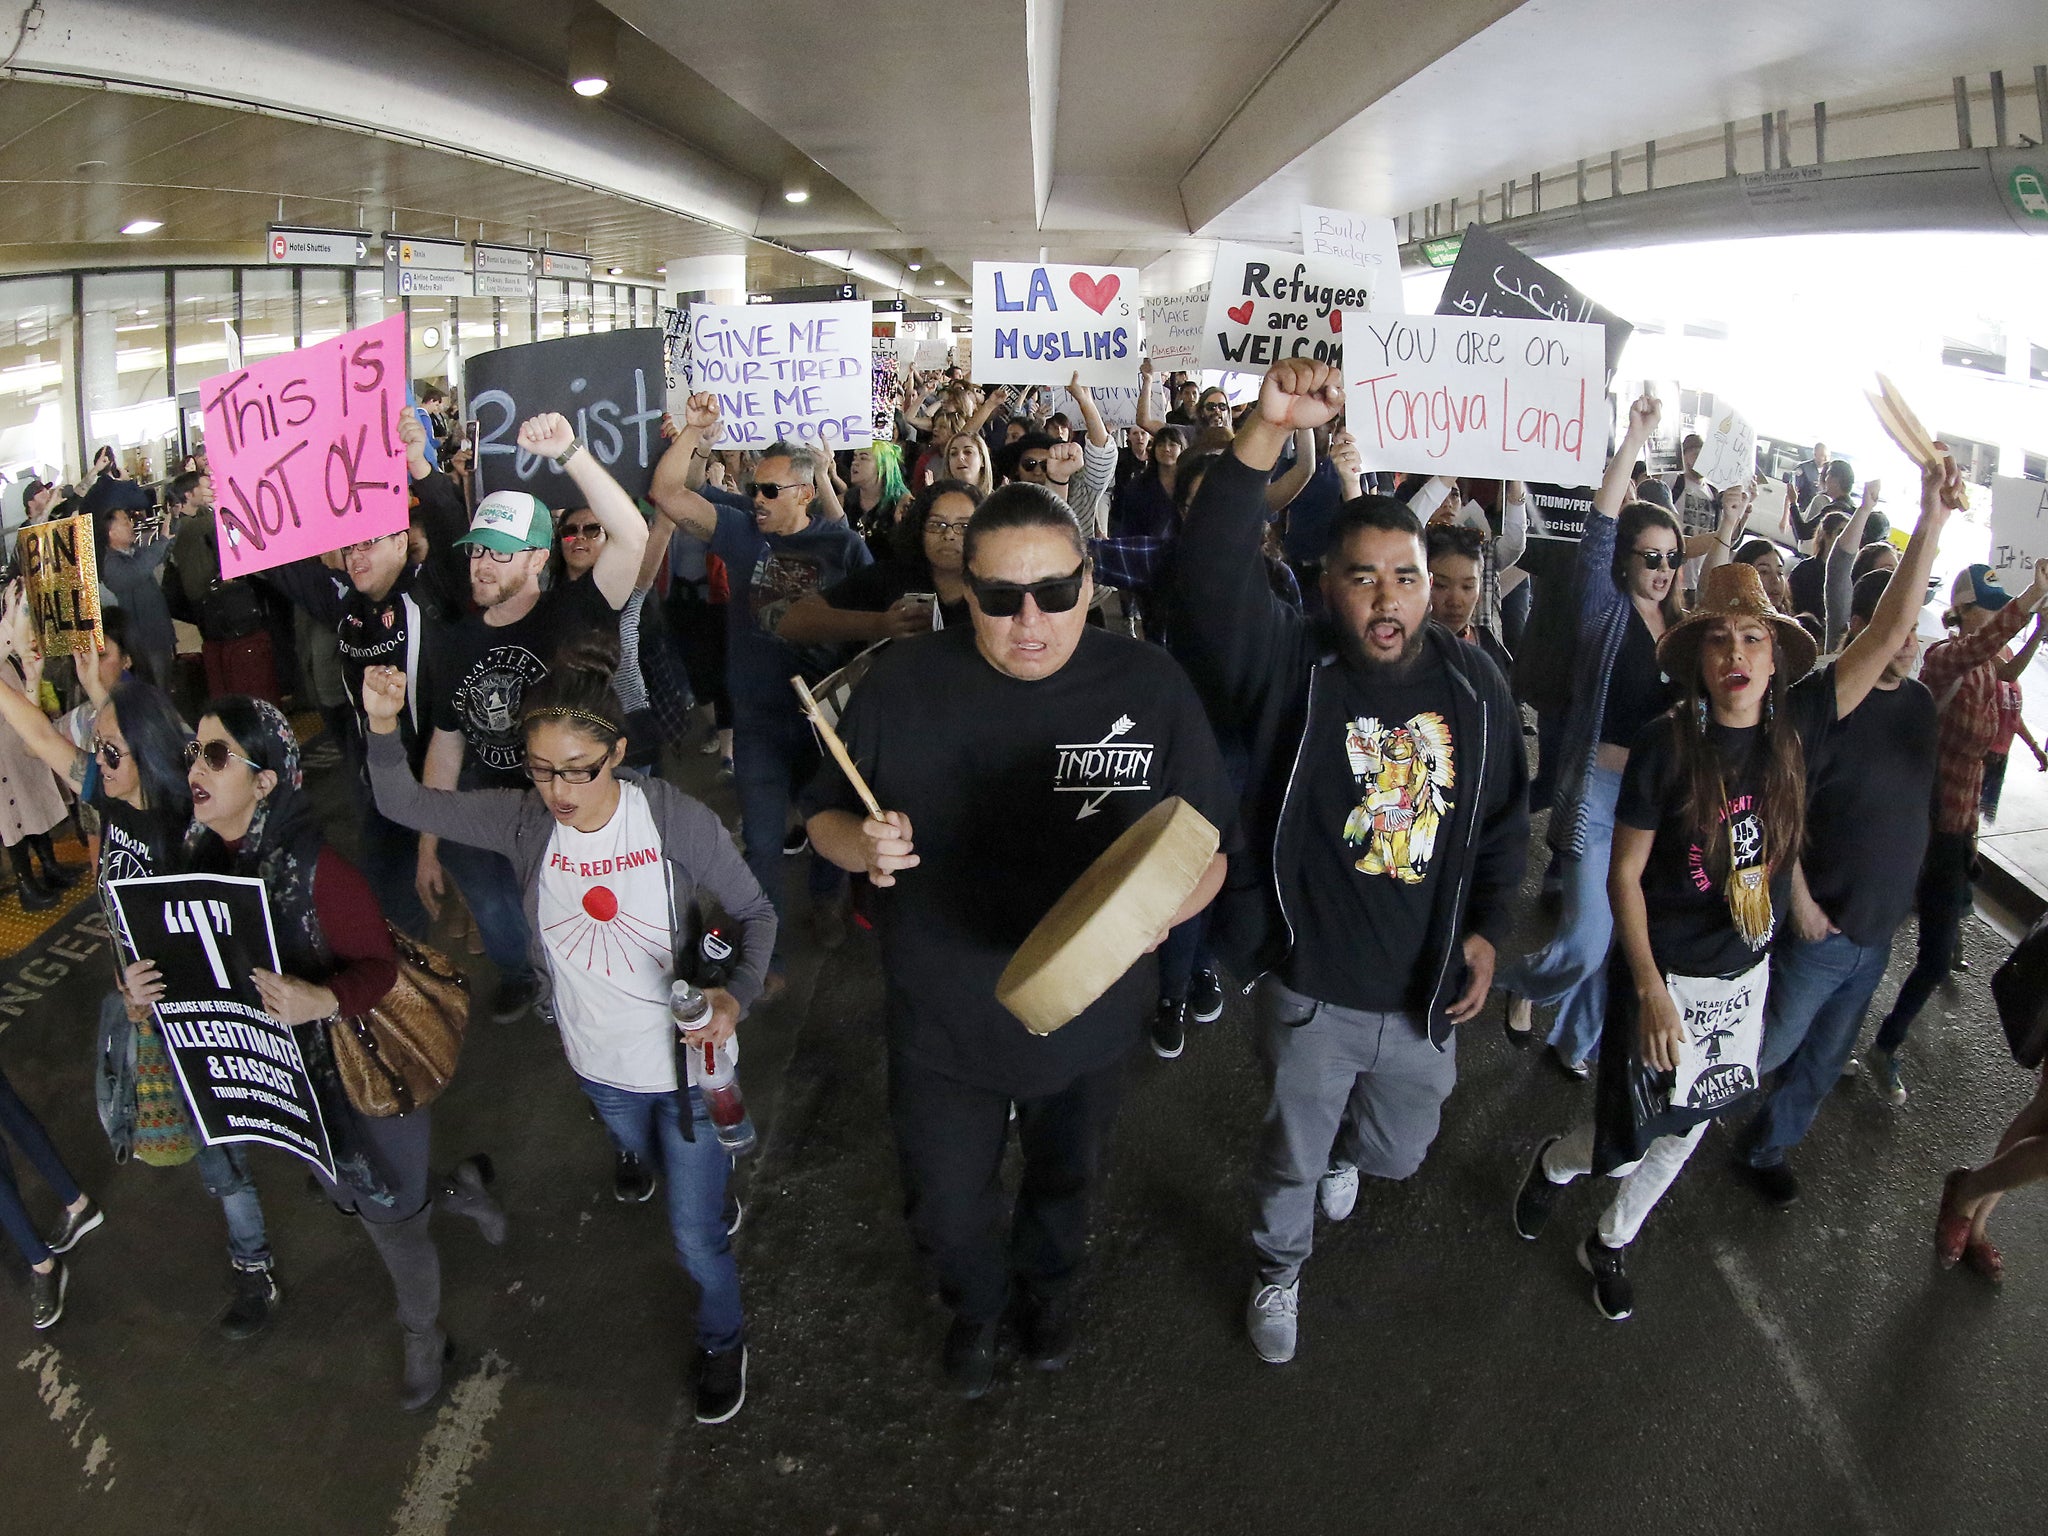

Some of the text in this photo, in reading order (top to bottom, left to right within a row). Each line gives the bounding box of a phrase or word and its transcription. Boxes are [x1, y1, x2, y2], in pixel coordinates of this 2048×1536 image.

[289, 242, 331, 252] Hotel Shuttles
[751, 285, 852, 304] Delta 5
[994, 267, 1058, 312] LA
[1242, 262, 1367, 318] Refugees
[896, 301, 903, 310] 5
[1152, 307, 1189, 323] MAKE
[789, 319, 840, 353] ME
[1169, 325, 1204, 337] AMERIC
[1268, 312, 1308, 330] are
[995, 327, 1128, 361] MUSLIMS
[1217, 331, 1343, 371] WELCOM
[1525, 336, 1569, 367] on
[696, 358, 769, 384] YOUR
[770, 357, 862, 382] TIRED
[207, 372, 316, 456] This
[718, 386, 829, 418] IVE ME
[775, 415, 871, 442] POOR
[1355, 373, 1585, 462] Tongva Land
[219, 440, 308, 561] NOT
[1535, 494, 1592, 512] TRUMP/PEN
[1996, 545, 2033, 570] It is
[1054, 749, 1153, 779] INDIAN
[580, 860, 612, 877] RED
[616, 847, 658, 872] FAWN
[158, 1001, 198, 1015] BECAUSE
[198, 1001, 214, 1012] WE
[214, 1001, 246, 1015] REFUSE
[244, 1005, 254, 1018] TO
[1696, 1000, 1706, 1009] WE
[166, 1020, 303, 1073] ILLEGITIMATE
[207, 1055, 298, 1098] & FASCIST
[1693, 1065, 1746, 1099] WATER
[211, 1086, 310, 1123] TRUMP-PENCE REGIME
[1708, 1085, 1736, 1104] IS LIFE
